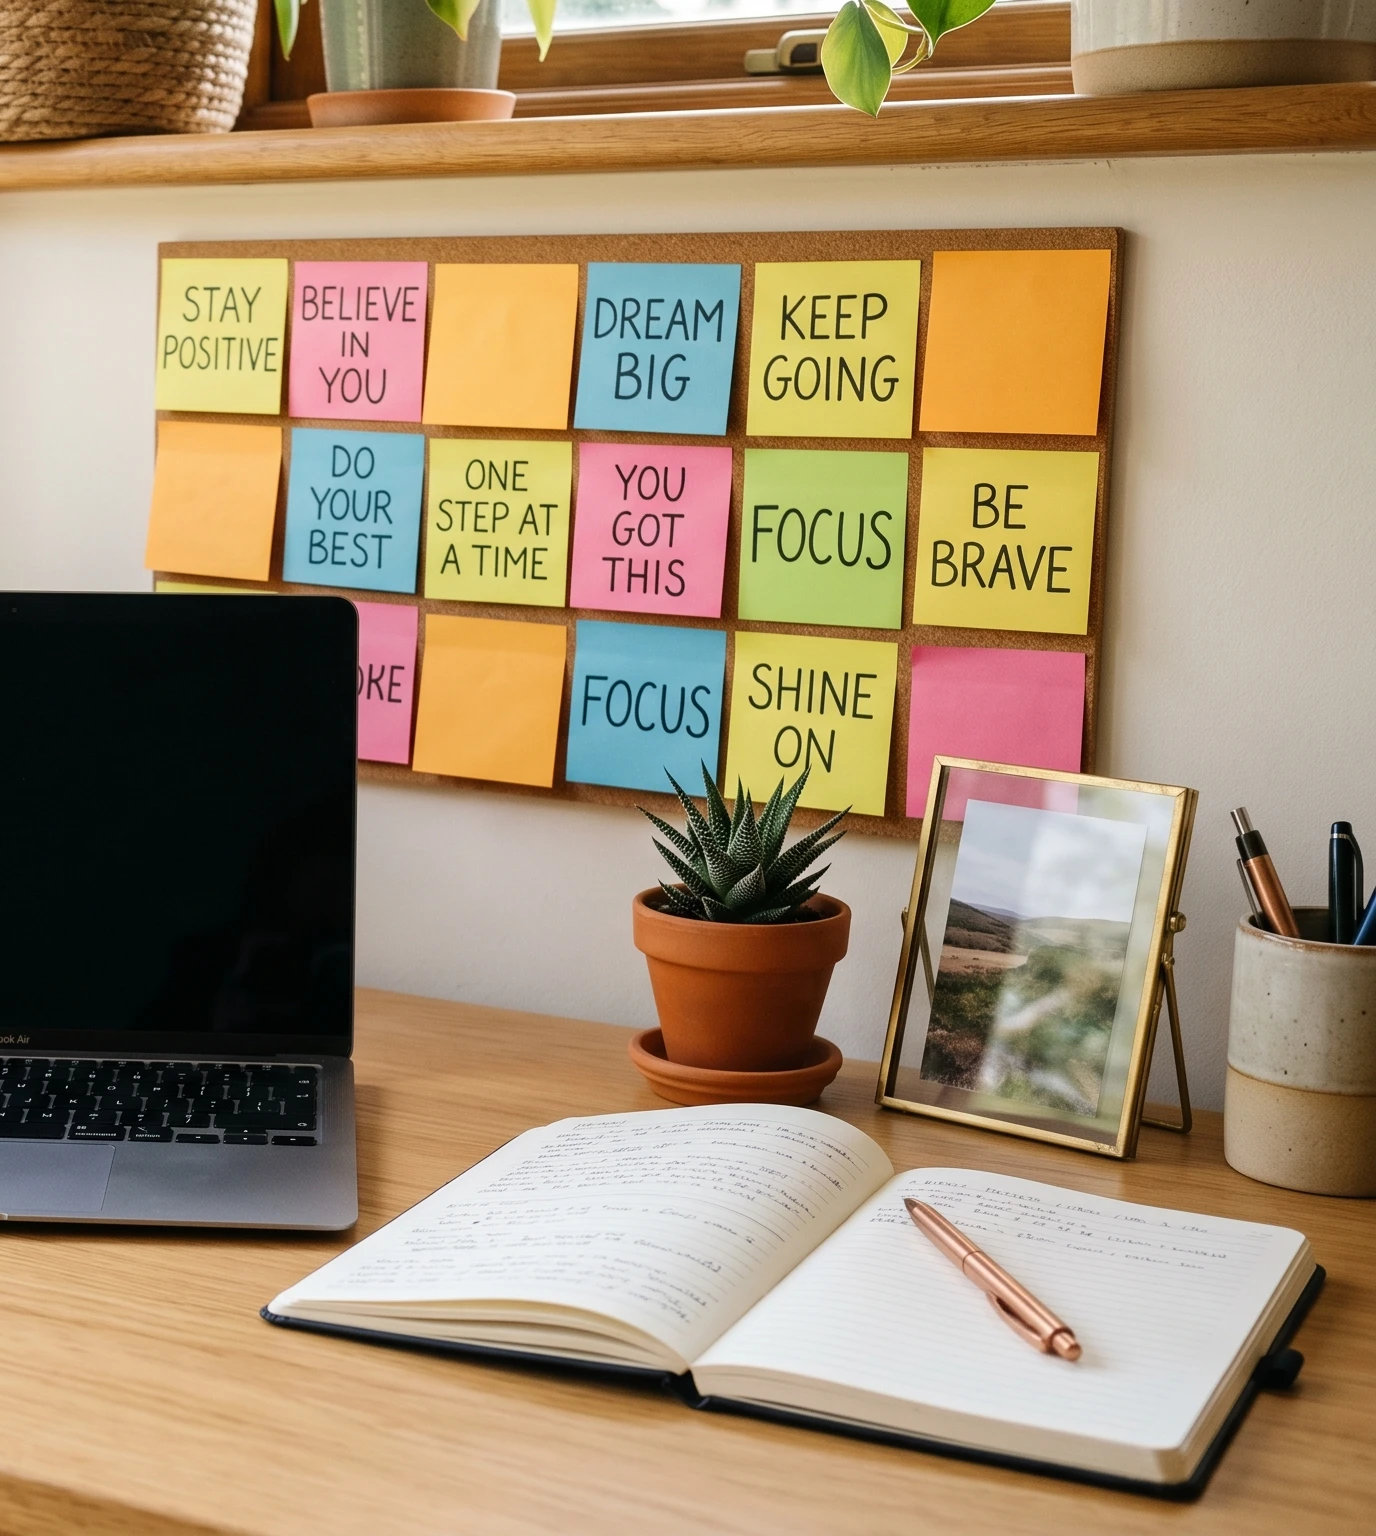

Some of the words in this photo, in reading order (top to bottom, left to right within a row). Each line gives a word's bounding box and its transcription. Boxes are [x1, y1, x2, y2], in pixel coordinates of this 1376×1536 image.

[183, 286, 261, 323] STAY
[302, 286, 419, 322] BELIEVE
[594, 298, 723, 342] DREAM
[781, 293, 887, 340] KEEP
[164, 335, 278, 372] POSITIVE
[342, 332, 369, 357] IN
[319, 367, 386, 404] YOU
[615, 352, 690, 401] BIG
[764, 355, 899, 402] GOING
[332, 445, 374, 479] DO
[466, 459, 528, 491] ONE
[615, 465, 685, 502] YOU
[311, 487, 392, 524] YOUR
[436, 499, 509, 533] STEP
[519, 504, 558, 536] AT
[973, 483, 1028, 529] BE
[612, 511, 684, 547] GOT
[752, 505, 892, 570] FOCUS
[309, 529, 392, 569] BEST
[441, 544, 460, 574] A
[472, 545, 548, 580] TIME
[932, 540, 1072, 593] BRAVE
[602, 557, 685, 597] THIS
[582, 675, 710, 738] FOCUS
[749, 663, 877, 719] SHINE
[774, 726, 835, 774] ON
[17, 1034, 30, 1044] Air
